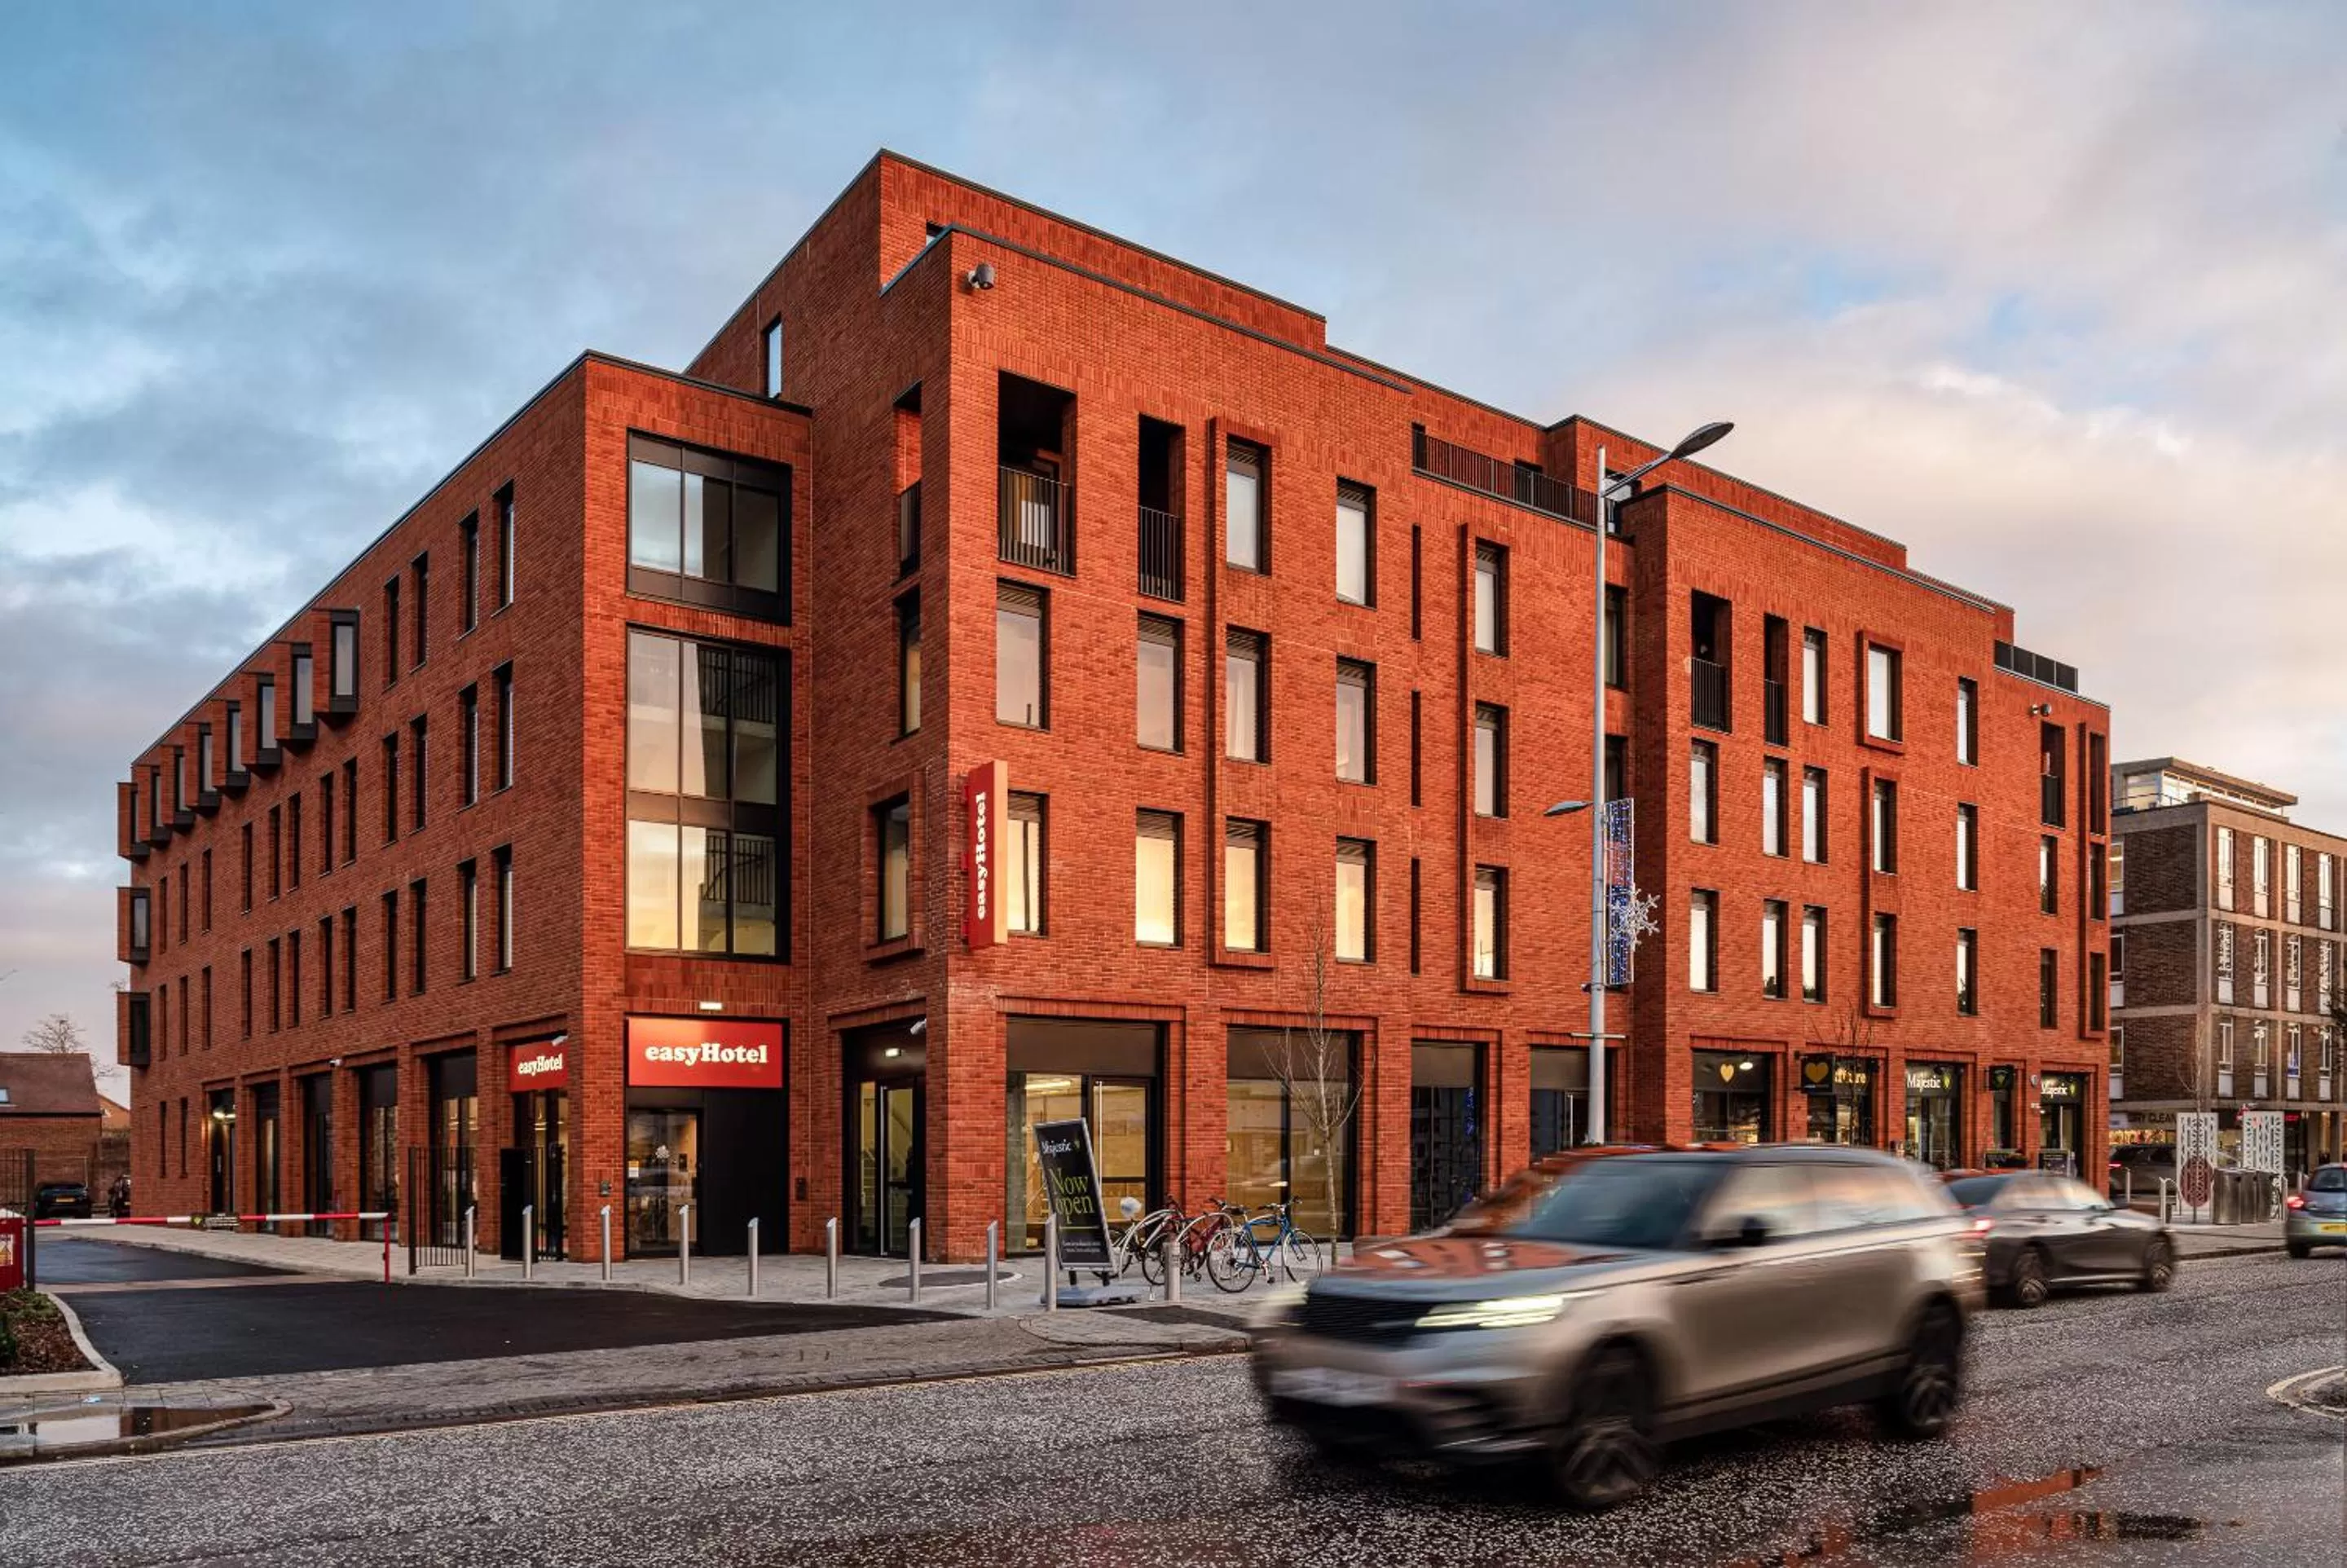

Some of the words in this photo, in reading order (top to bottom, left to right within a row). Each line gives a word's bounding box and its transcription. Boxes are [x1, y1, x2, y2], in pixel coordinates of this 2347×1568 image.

[975, 791, 988, 920] easyHotel
[518, 1053, 563, 1077] easyHotel
[645, 1042, 768, 1066] easyHotel
[1907, 1073, 1941, 1093] Majestic
[1041, 1139, 1071, 1156] Majestic
[1049, 1167, 1088, 1195] Now
[1055, 1196, 1094, 1224] open
